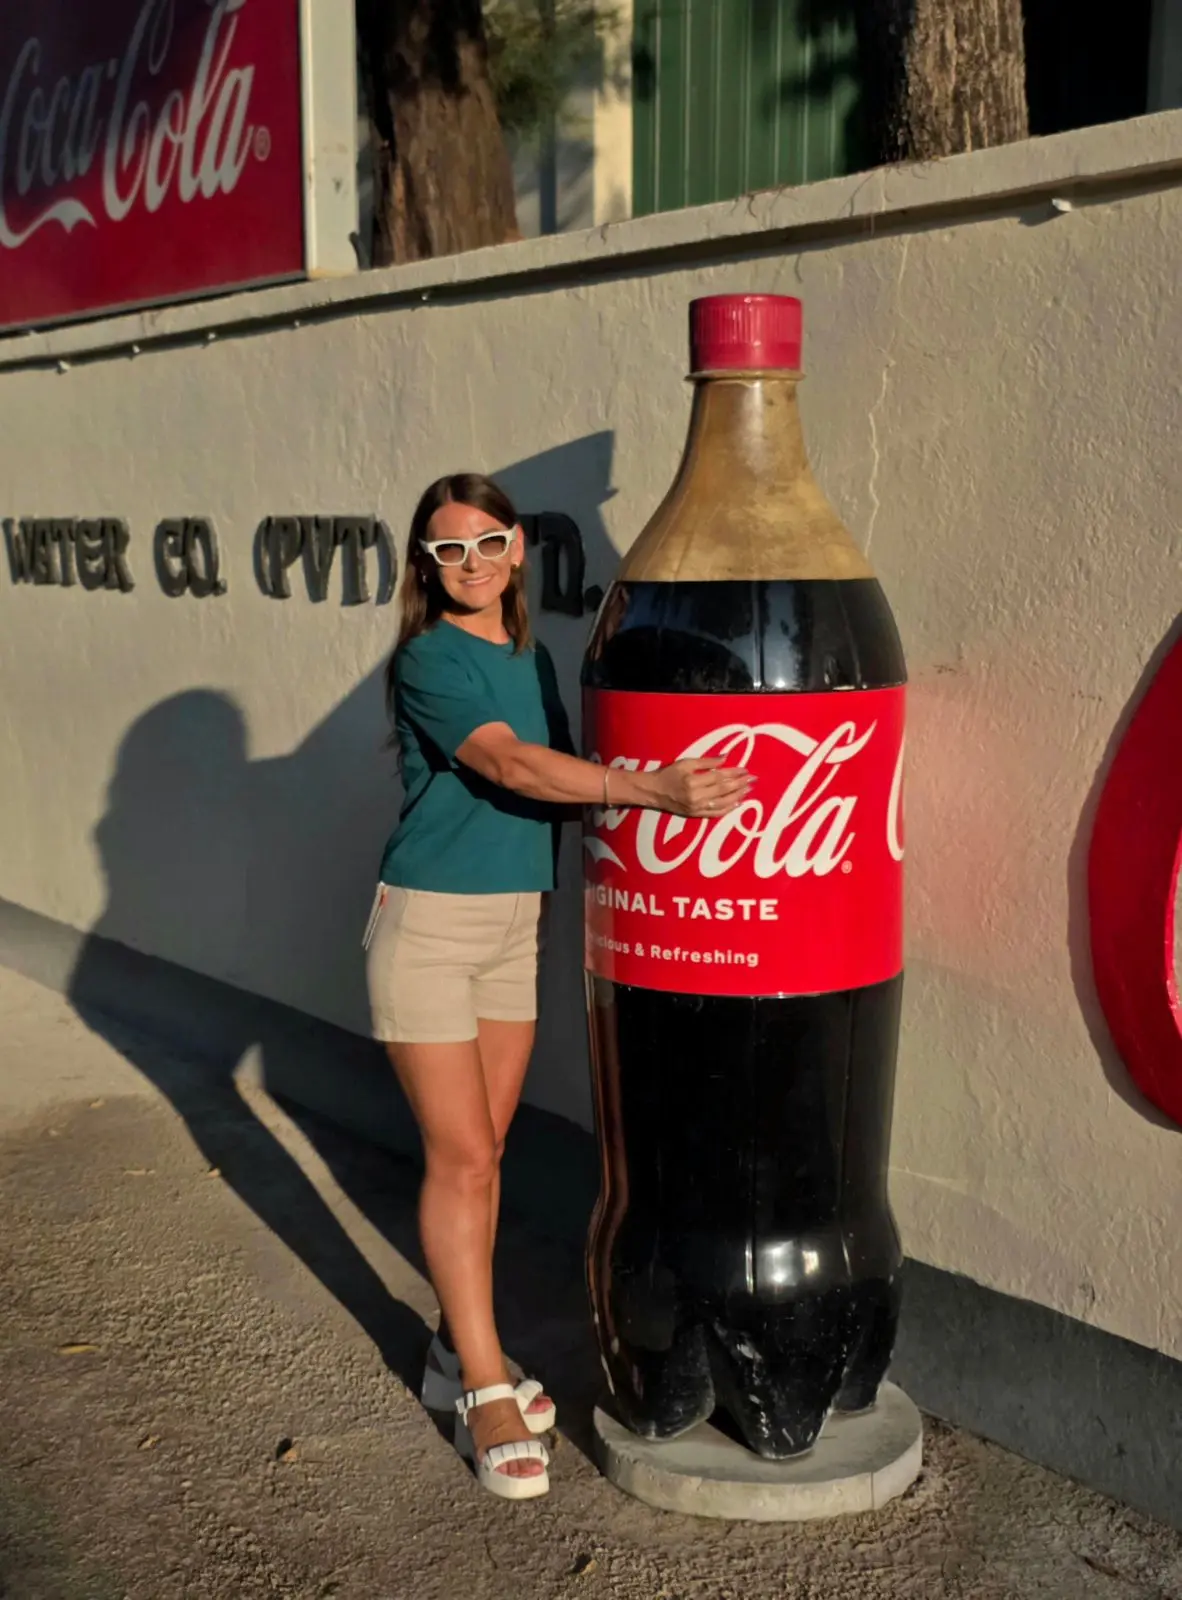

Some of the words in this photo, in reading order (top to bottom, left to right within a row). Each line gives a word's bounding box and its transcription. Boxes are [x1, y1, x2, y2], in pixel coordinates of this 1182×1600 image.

[2, 516, 135, 593] WATER
[253, 514, 398, 607] (PVT)
[672, 896, 779, 921] TASTE
[634, 942, 645, 957] &
[650, 944, 760, 968] Refreshing
